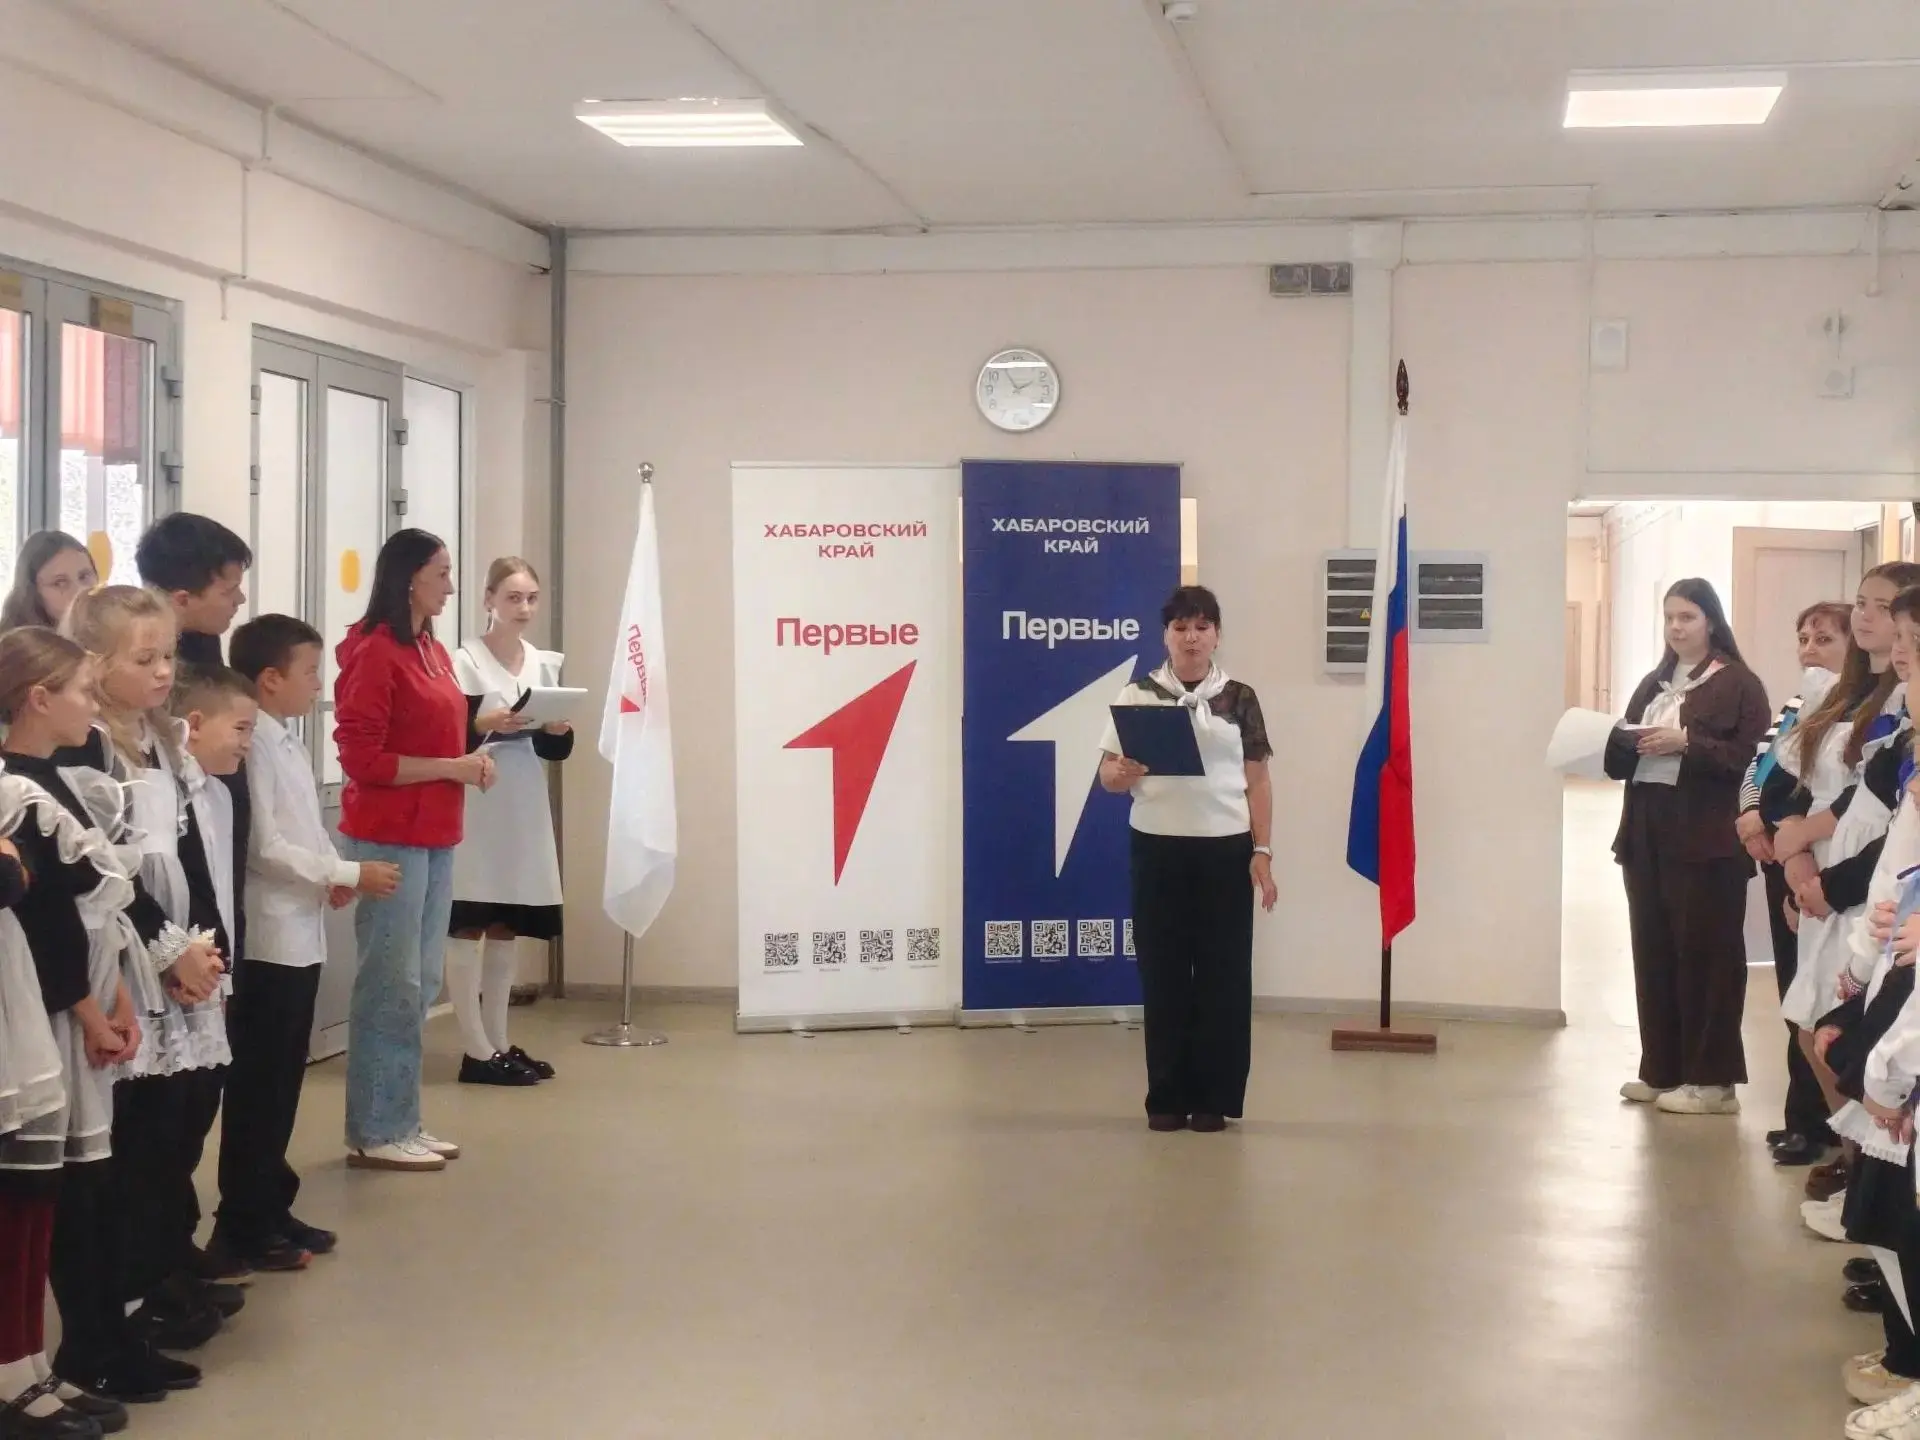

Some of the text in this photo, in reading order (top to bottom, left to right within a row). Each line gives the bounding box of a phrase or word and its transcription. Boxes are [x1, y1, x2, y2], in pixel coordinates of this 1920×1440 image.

[765, 521, 927, 538] ХАБАРОВСКИЙ
[992, 516, 1150, 534] ХАБАРОВСКИЙ
[819, 541, 874, 558] КРАЙ
[1044, 537, 1099, 554] КРАЙ
[776, 617, 919, 655] Первые
[1002, 610, 1140, 649] Первые
[627, 623, 648, 706] Первы
